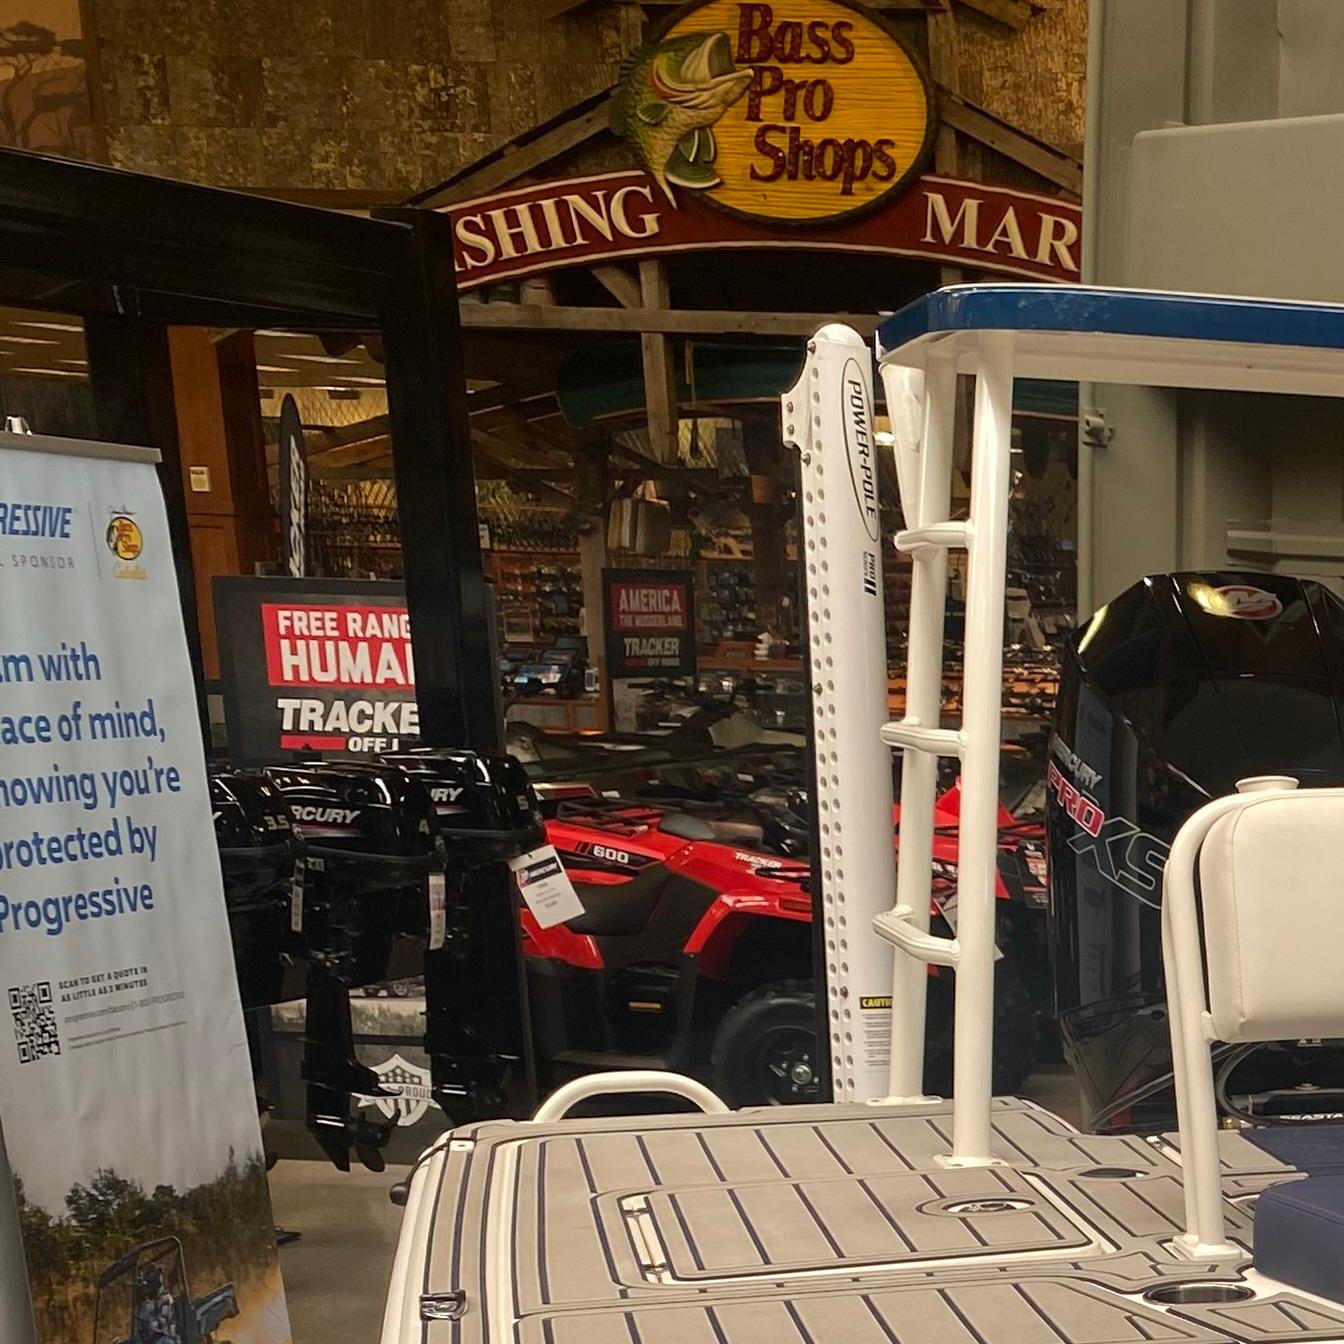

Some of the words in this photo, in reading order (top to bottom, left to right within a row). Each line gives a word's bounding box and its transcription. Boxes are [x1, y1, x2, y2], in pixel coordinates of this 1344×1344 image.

[735, 3, 855, 65] Bass
[745, 66, 835, 122] Pro
[750, 124, 897, 195] Shops
[454, 186, 661, 272] SHING
[920, 191, 1080, 272] MAR
[847, 378, 877, 520] POWER-POLE
[11, 554, 76, 570] SPONSOR
[620, 588, 682, 613] AMERICA
[277, 610, 340, 637] FREE
[38, 641, 102, 682] with
[623, 637, 680, 656] TRACKER
[0, 712, 52, 745] ace
[57, 700, 81, 742] of
[88, 698, 166, 743] mind,
[348, 737, 387, 752] OFF
[1048, 759, 1105, 838] PRO
[126, 816, 158, 862] by
[264, 815, 290, 830] 3.5
[418, 819, 430, 835] 4
[593, 845, 630, 864] 600
[0, 876, 154, 936] Progressive
